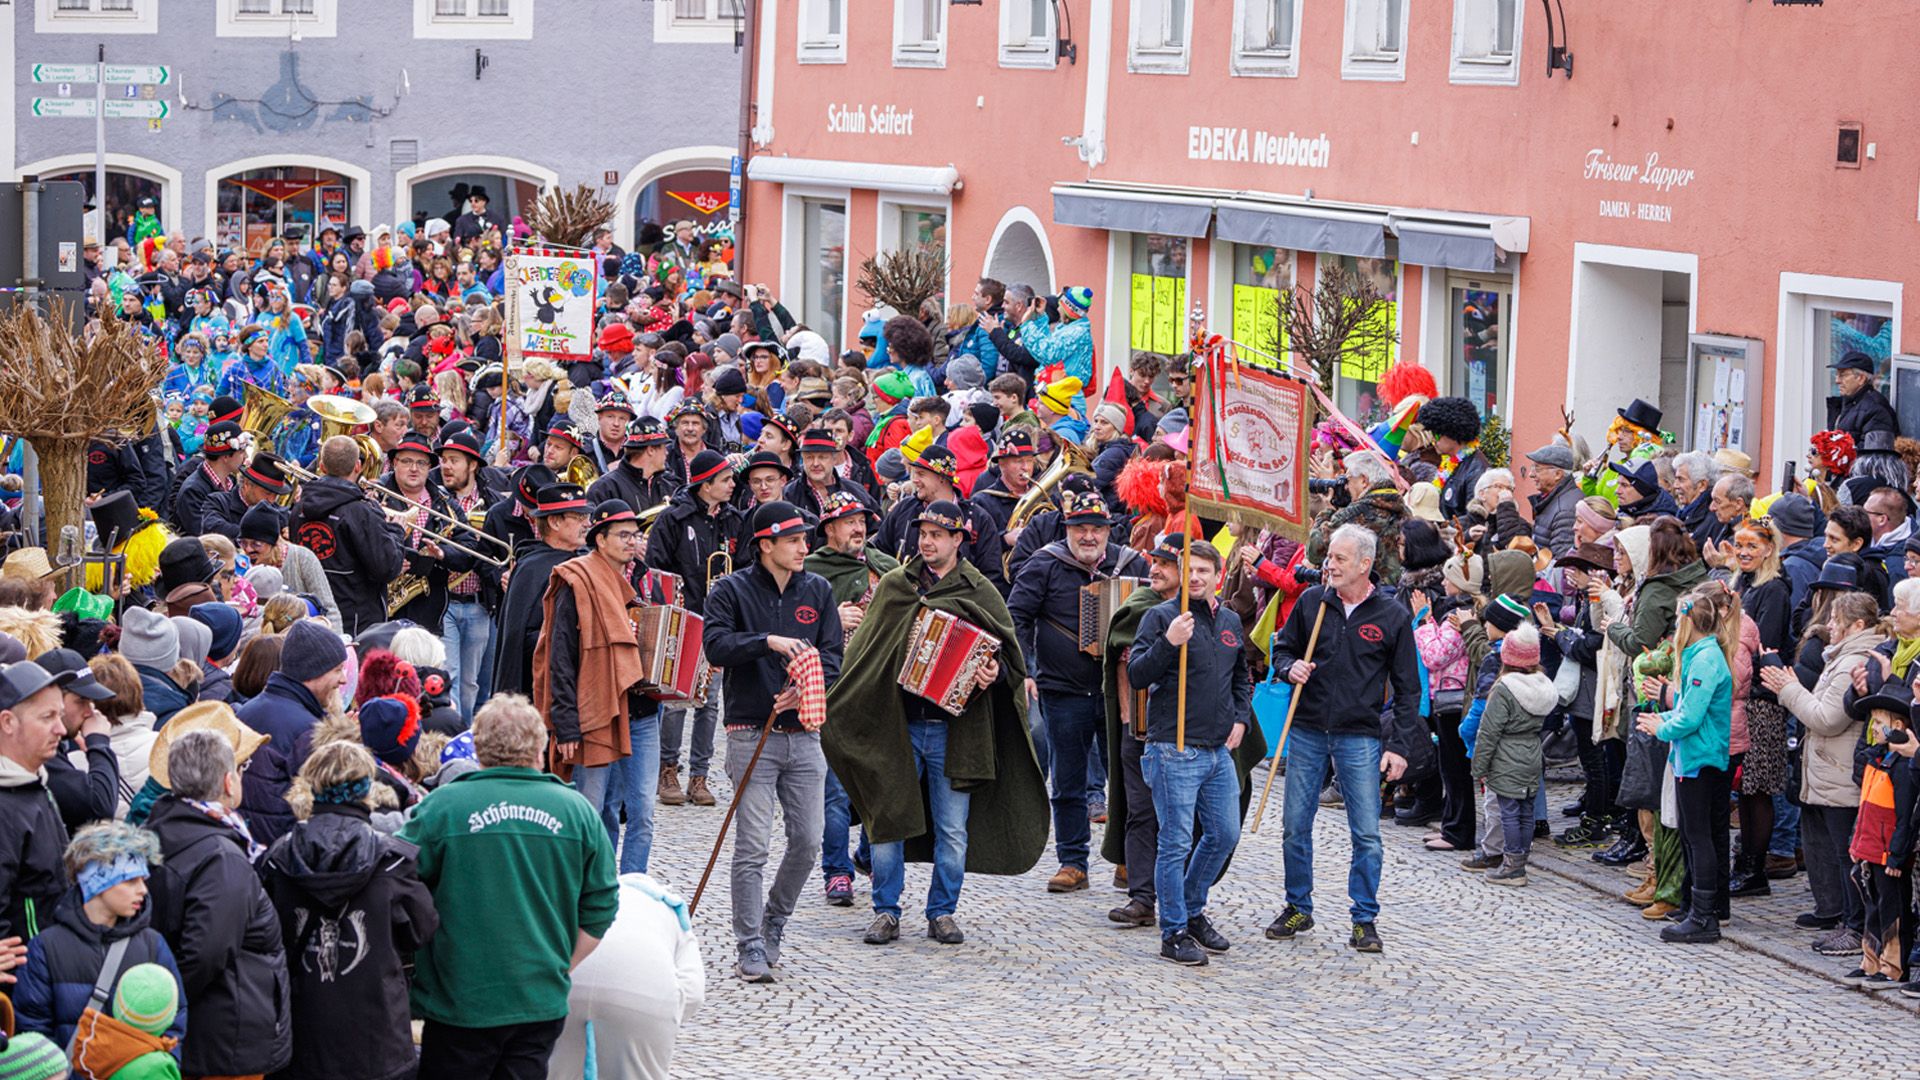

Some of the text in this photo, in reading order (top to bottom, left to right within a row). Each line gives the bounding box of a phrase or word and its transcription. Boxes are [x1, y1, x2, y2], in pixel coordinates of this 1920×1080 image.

[827, 103, 914, 136] Schuh Seifert
[1188, 126, 1330, 168] EDEKA Neubach
[1583, 148, 1695, 192] Friseur Lapper
[1599, 200, 1630, 218] DAMEN
[1637, 203, 1672, 223] HERREN
[467, 800, 563, 835] Schönramer
